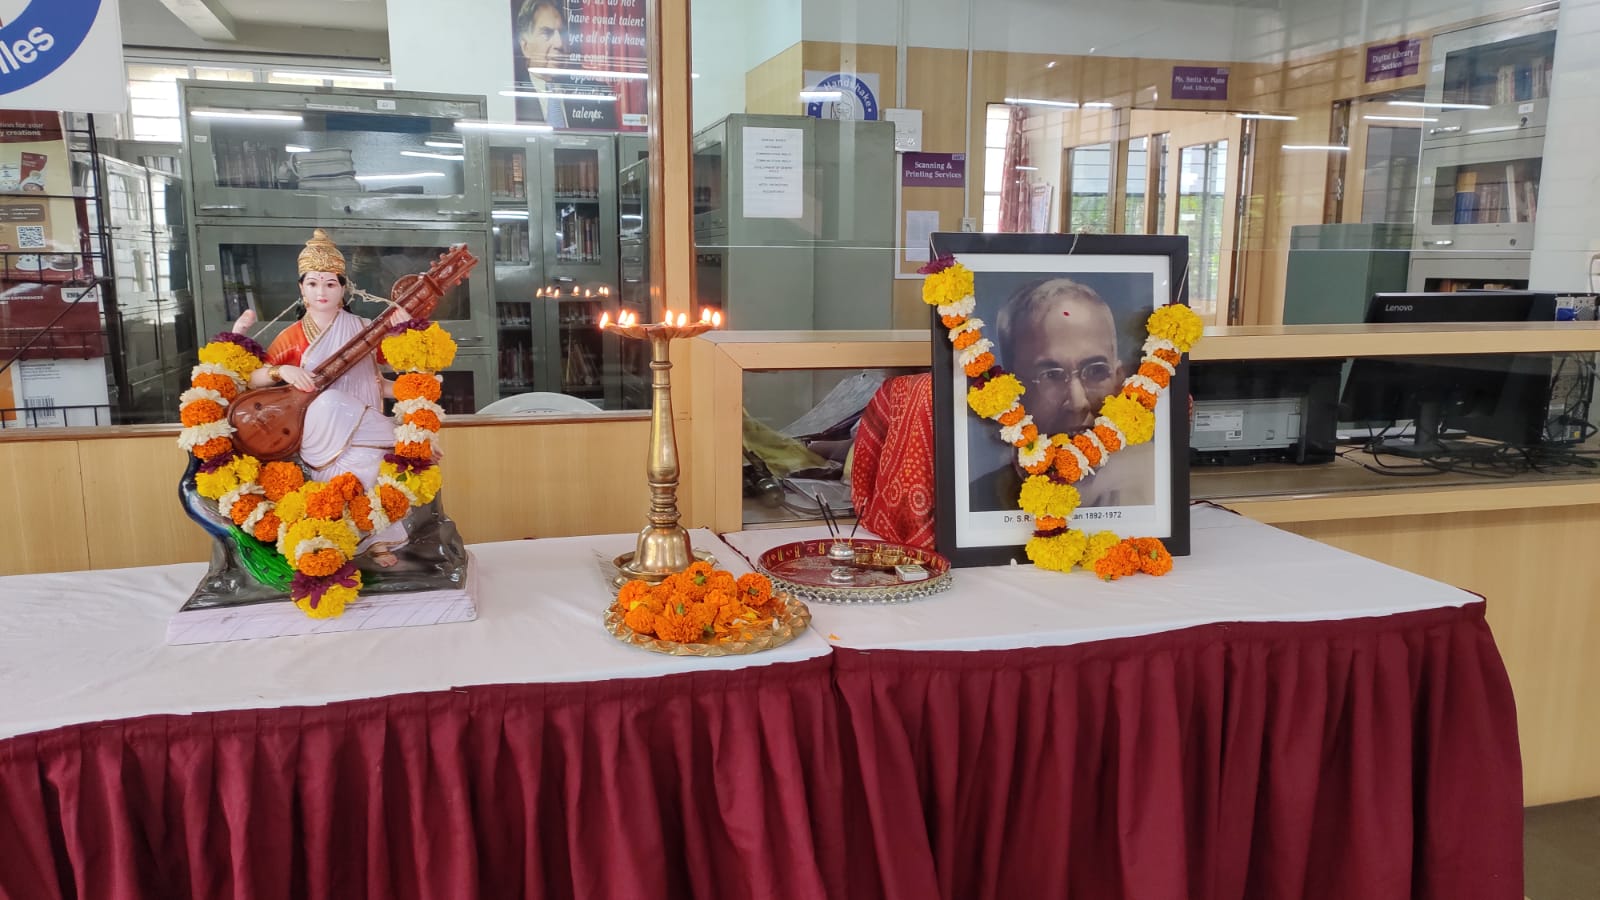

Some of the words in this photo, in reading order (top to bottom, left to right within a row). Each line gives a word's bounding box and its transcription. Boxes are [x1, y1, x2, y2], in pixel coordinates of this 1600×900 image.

[568, 9, 590, 24] have
[592, 13, 616, 27] equal
[618, 14, 645, 27] talent
[568, 32, 583, 46] yet
[586, 31, 598, 44] all
[599, 32, 611, 46] of
[611, 34, 622, 44] us
[623, 32, 645, 46] have
[1372, 53, 1392, 64] Digital
[1392, 50, 1414, 59] Library
[1380, 61, 1403, 71] Section
[572, 106, 604, 122] talents.
[914, 161, 945, 170] Scanning
[905, 170, 933, 179] Printing
[1085, 511, 1122, 520] 1892-1972
